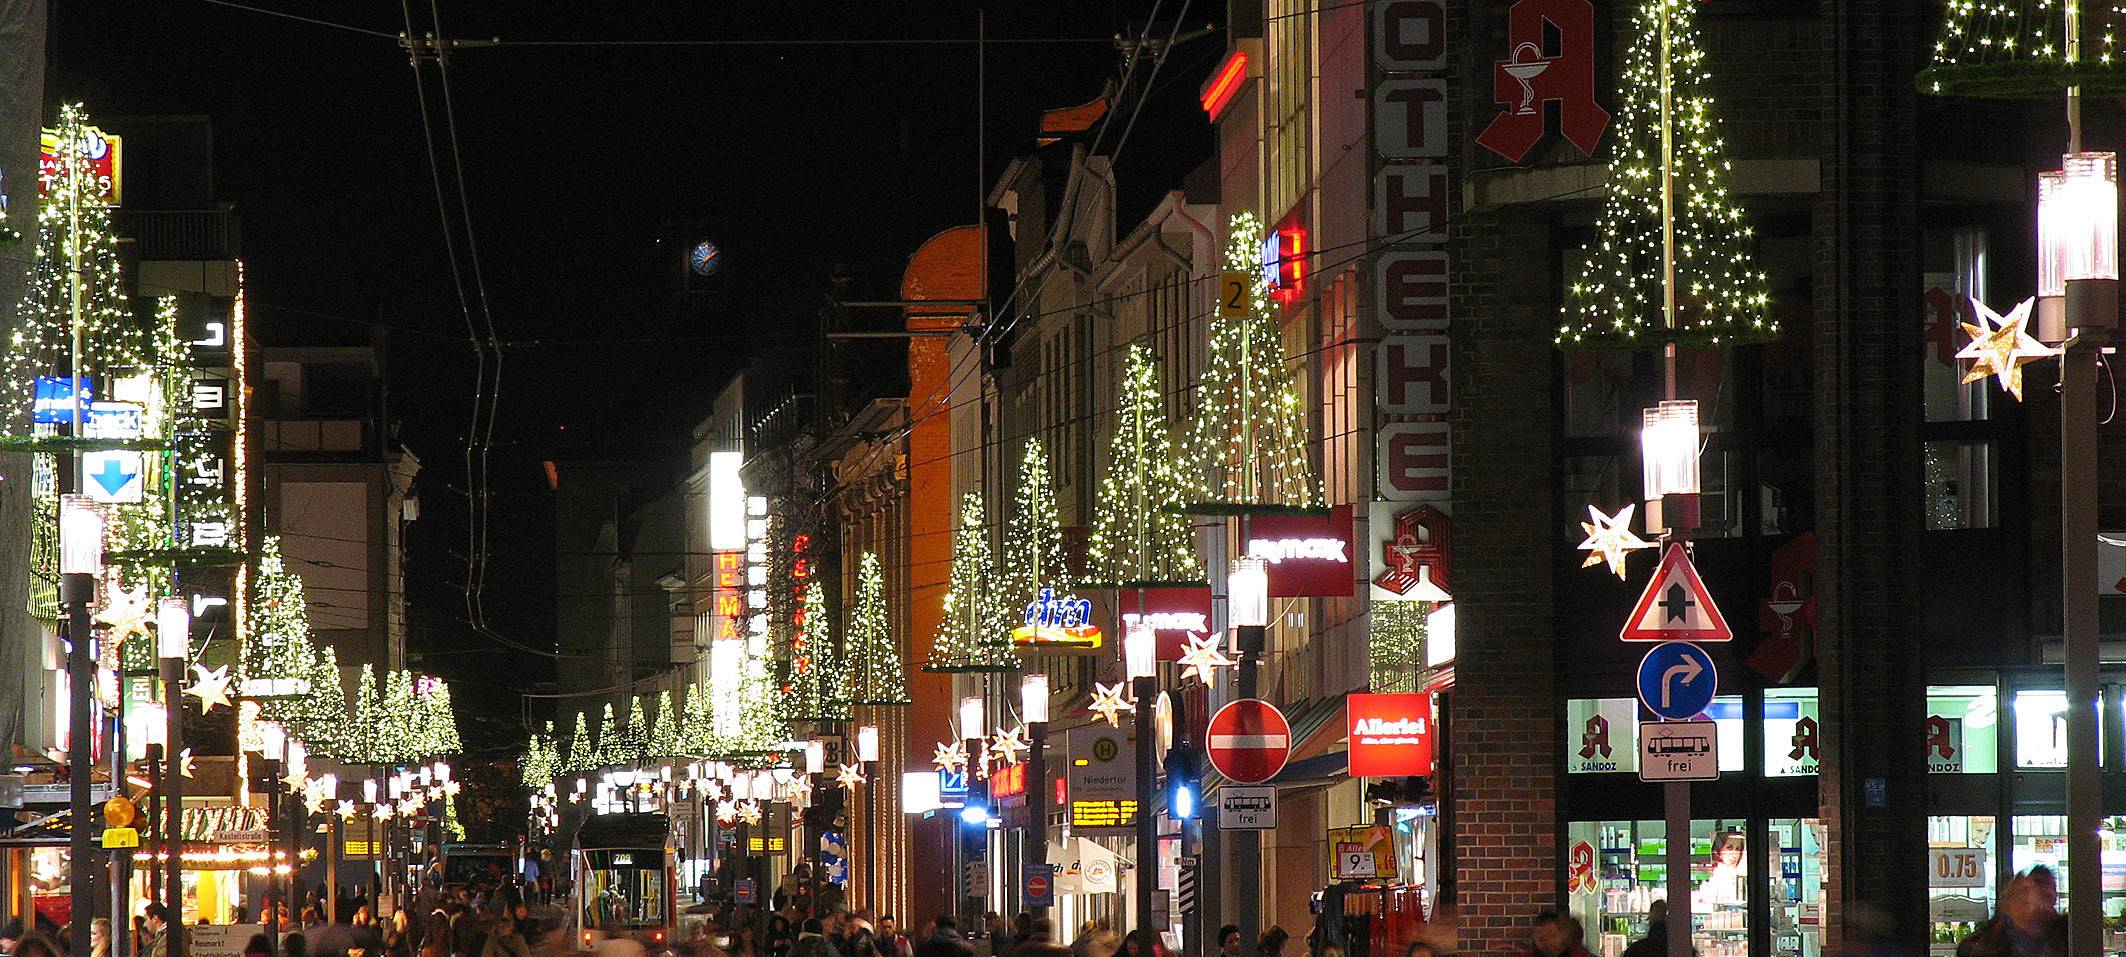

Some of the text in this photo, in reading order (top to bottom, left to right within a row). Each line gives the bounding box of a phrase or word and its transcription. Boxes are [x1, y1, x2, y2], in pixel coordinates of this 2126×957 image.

[1227, 281, 1243, 309] 2
[719, 550, 740, 641] HEMA
[1025, 587, 1092, 628] dm
[1353, 717, 1426, 735] Allerlei
[1581, 762, 1617, 771] SANDOZ
[1668, 760, 1692, 772] frei
[1084, 775, 1126, 785] Niedertor
[1239, 813, 1258, 825] frei
[615, 854, 631, 862] 709
[1937, 853, 1977, 878] 0.75
